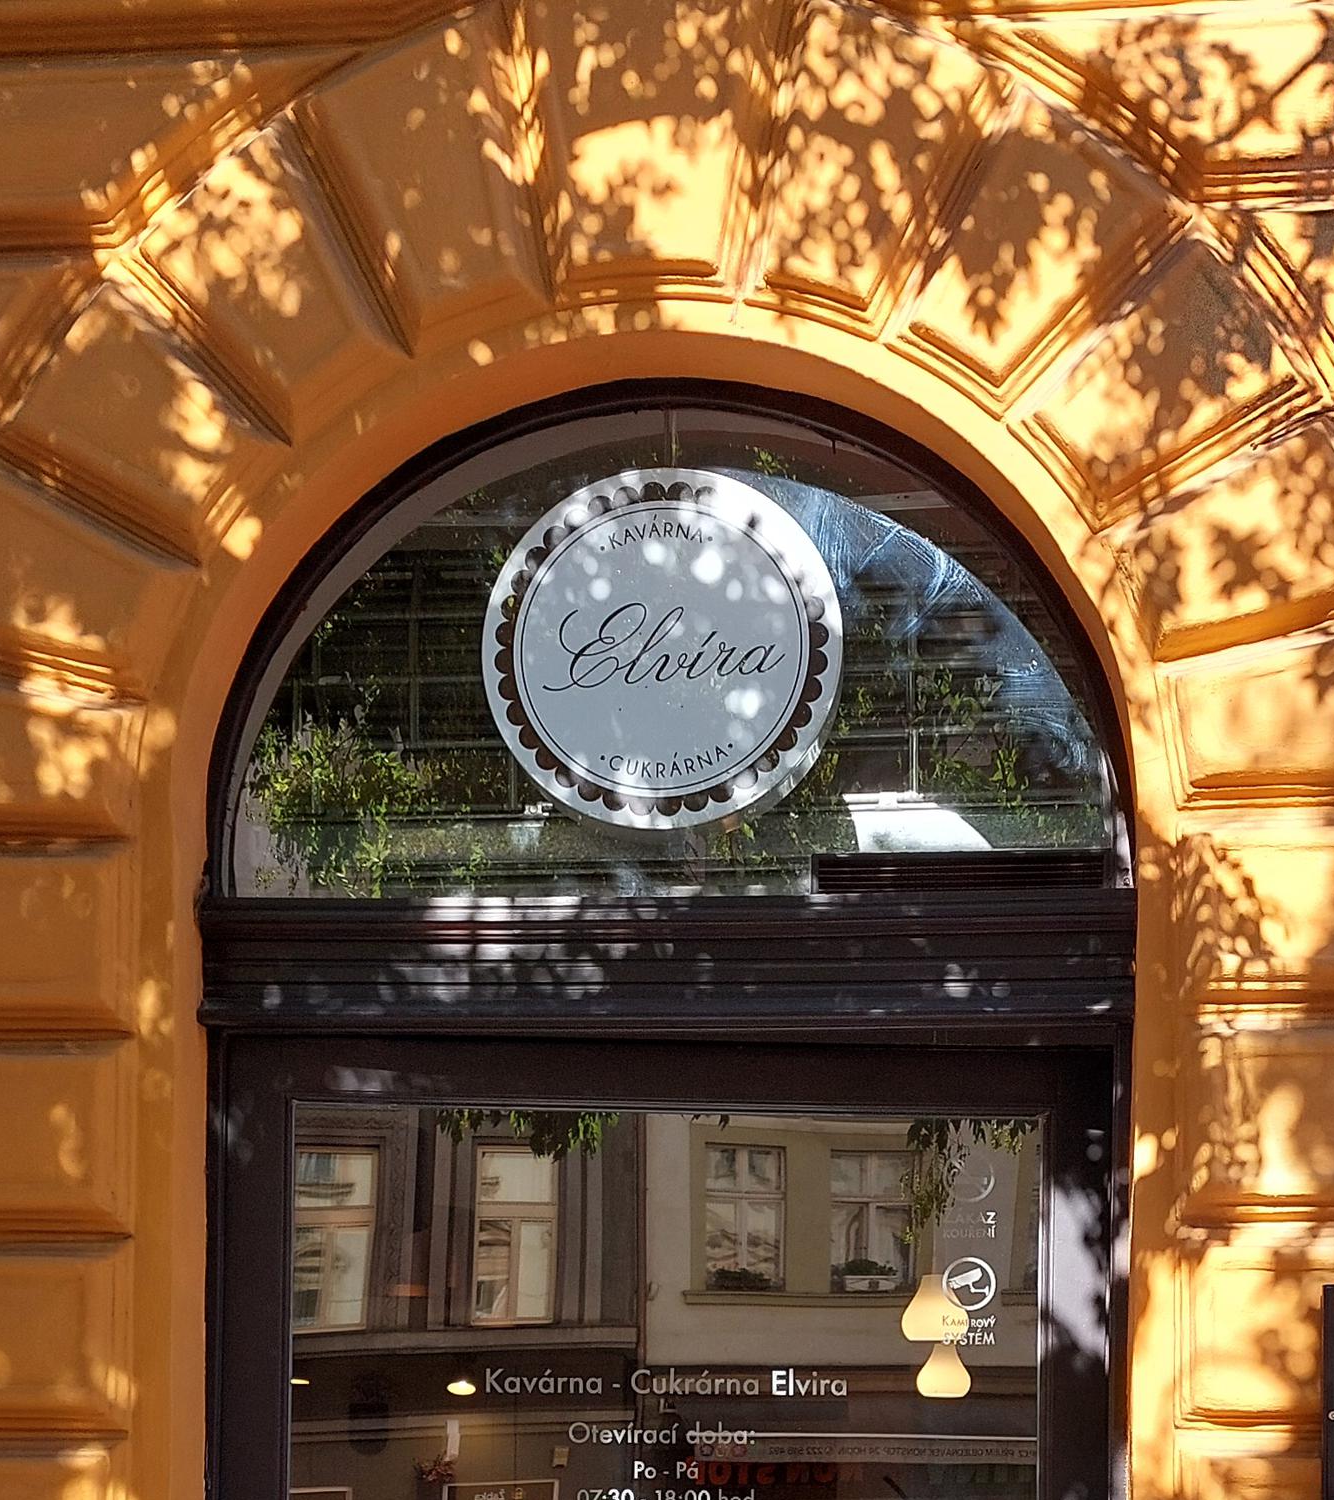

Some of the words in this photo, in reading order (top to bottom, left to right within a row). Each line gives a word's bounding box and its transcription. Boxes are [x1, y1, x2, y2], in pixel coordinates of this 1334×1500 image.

[608, 514, 705, 548] KAVÁRNA
[542, 602, 786, 692] Elvíra
[608, 744, 725, 779] CUKRÁRNA
[943, 1328, 996, 1345] SYSTÉM
[485, 1368, 603, 1395] Kavárna
[631, 1368, 759, 1396] Cukrárna
[771, 1370, 848, 1397] Elvira
[569, 1421, 677, 1445] Otevírací
[686, 1421, 756, 1446] doba:
[633, 1461, 656, 1480] Po
[676, 1460, 700, 1480] Pá
